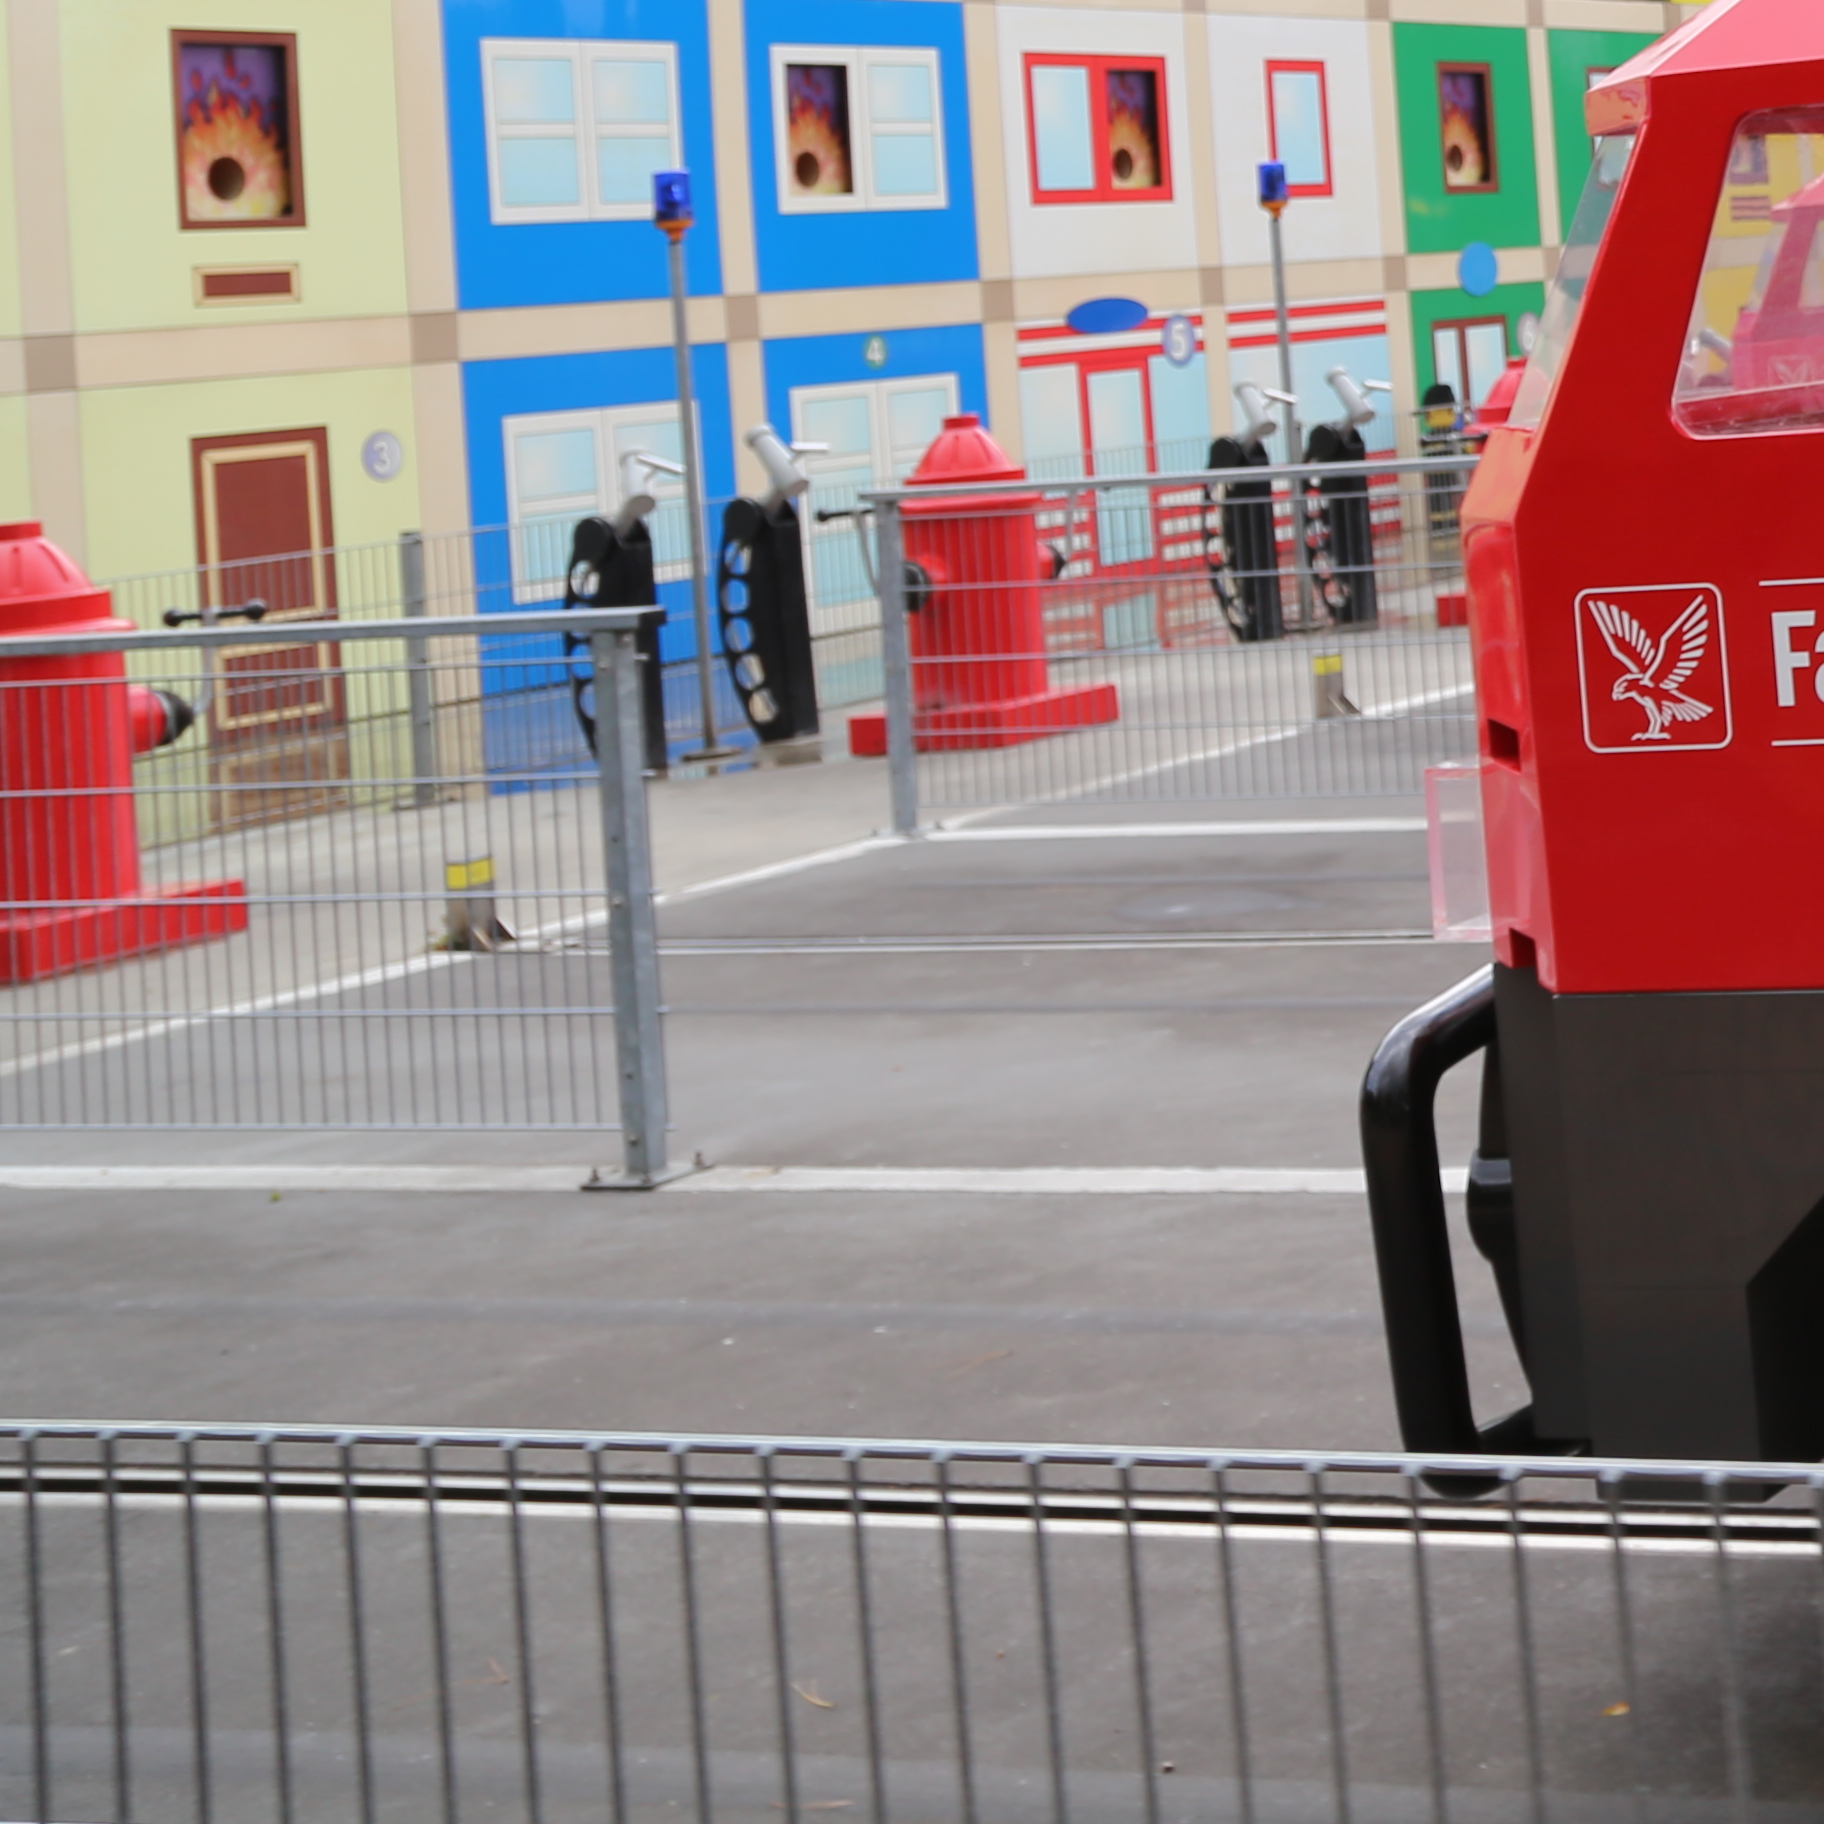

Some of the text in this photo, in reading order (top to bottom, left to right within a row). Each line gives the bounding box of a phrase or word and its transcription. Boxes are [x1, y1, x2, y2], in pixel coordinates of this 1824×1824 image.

[865, 338, 884, 366] 4
[1170, 321, 1187, 361] 5
[371, 440, 392, 475] 3
